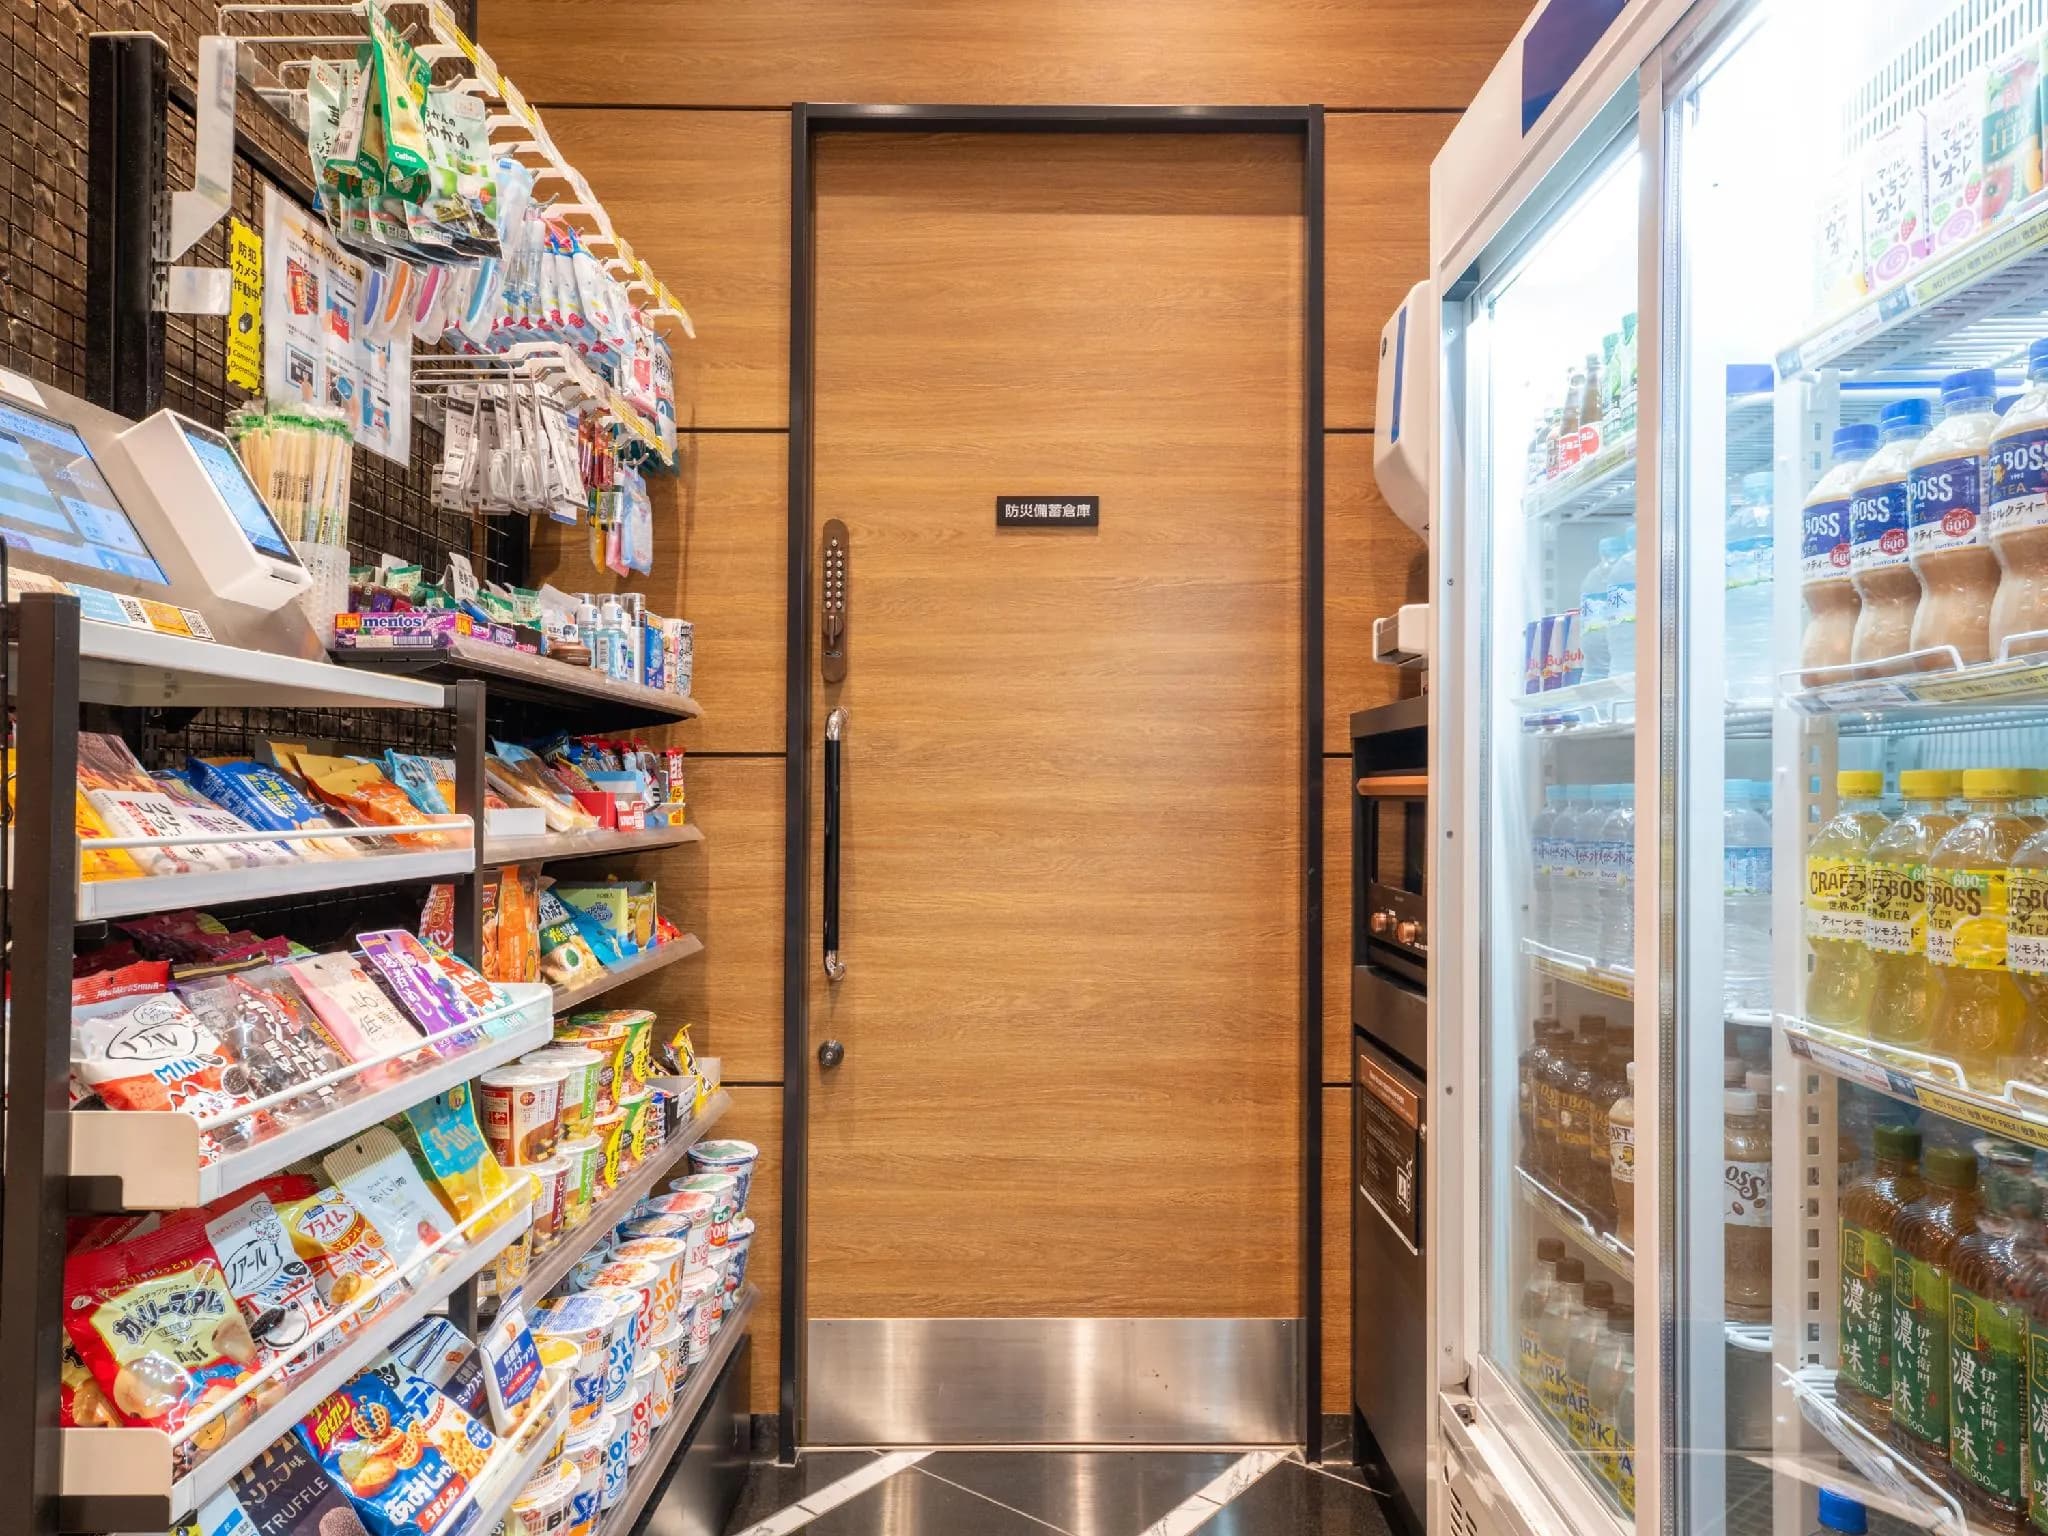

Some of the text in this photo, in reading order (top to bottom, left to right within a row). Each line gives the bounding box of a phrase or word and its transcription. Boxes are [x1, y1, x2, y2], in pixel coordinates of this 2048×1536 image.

[394, 151, 417, 163] Calbee
[237, 241, 258, 265] 防犯
[235, 259, 258, 284] カメラ
[233, 278, 260, 302] 作動中
[233, 336, 257, 354] Security
[230, 360, 259, 381] Operating
[232, 349, 257, 368] Cameras
[1909, 473, 1953, 501] BOSS
[1005, 503, 1091, 518] 防災備蓄倉庫
[1851, 496, 1890, 522] BOSS
[1805, 512, 1841, 537] BOSS
[1946, 518, 1970, 531] 600
[1883, 538, 1906, 550] 600
[362, 616, 424, 628] mentos
[1889, 880, 1925, 903] BOS
[1934, 886, 1981, 917] BOSS
[1828, 901, 1867, 913] 世界のT
[1820, 915, 1865, 927] ティーレモ
[1725, 1166, 1765, 1200] OSS
[303, 1209, 348, 1238] プライム
[231, 1247, 268, 1289] ノアール
[1843, 1278, 1865, 1374] 濃い味
[1868, 1291, 1884, 1350] 伊右衛門
[499, 1343, 536, 1387] ミックスナッツ
[1893, 1308, 1915, 1413] 濃い味
[1917, 1324, 1932, 1389] 伊右衛門
[1952, 1348, 1979, 1463] 濃い味
[1980, 1367, 1999, 1437] 伊右衛門
[261, 1476, 329, 1536] TRUFFLE
